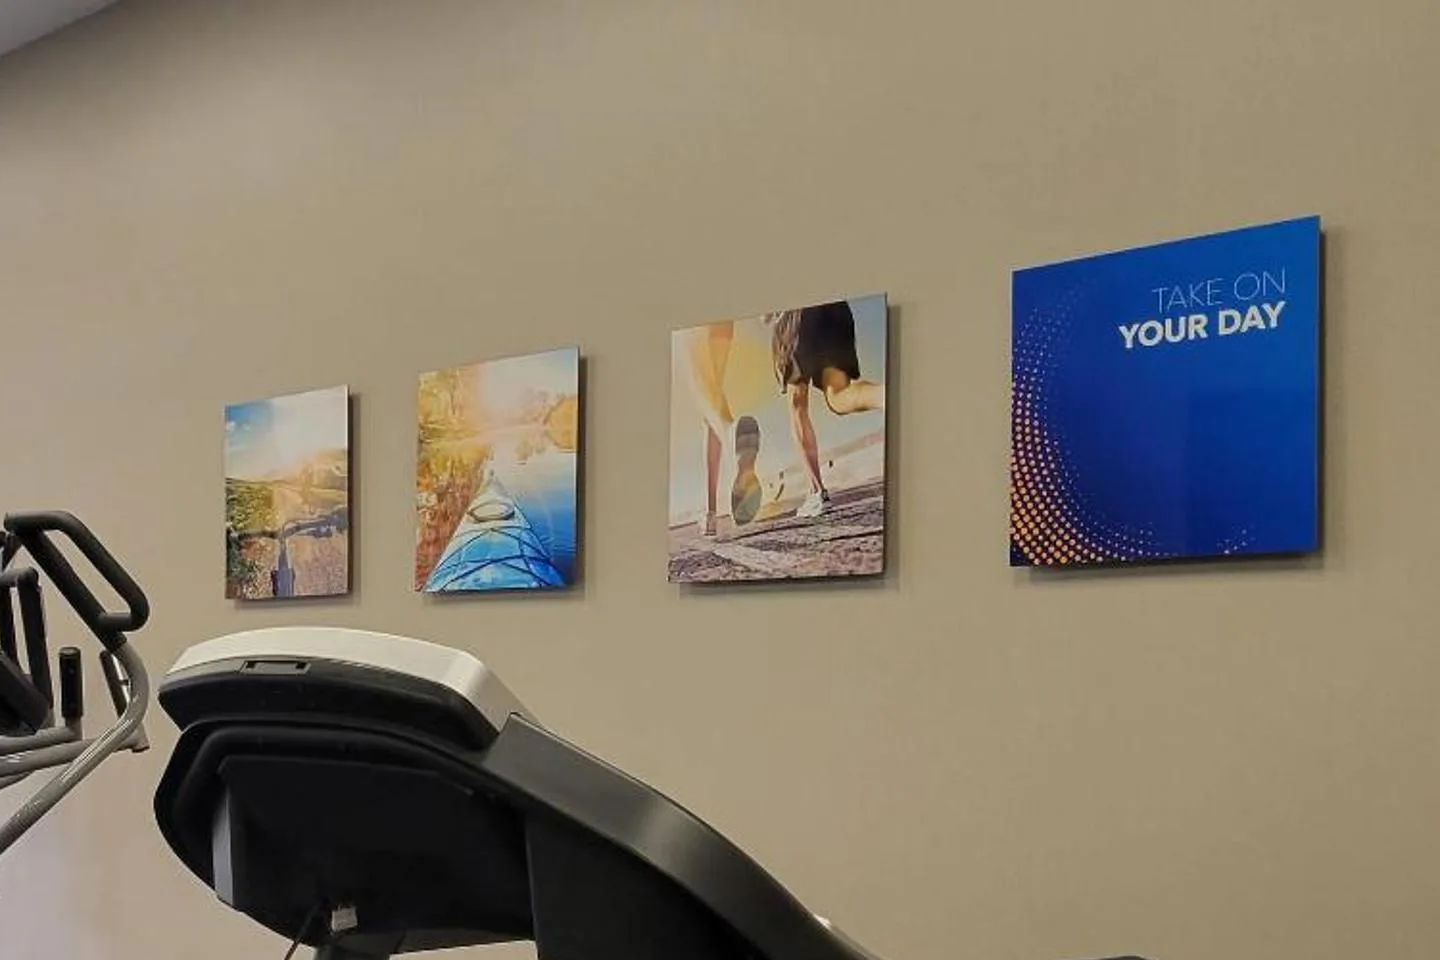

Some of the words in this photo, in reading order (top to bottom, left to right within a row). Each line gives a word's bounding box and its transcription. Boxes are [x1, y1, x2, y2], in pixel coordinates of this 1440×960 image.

[1151, 277, 1223, 313] TAKE
[1233, 267, 1287, 301] ON
[1118, 314, 1209, 349] YOUR
[1218, 300, 1287, 336] DAY
